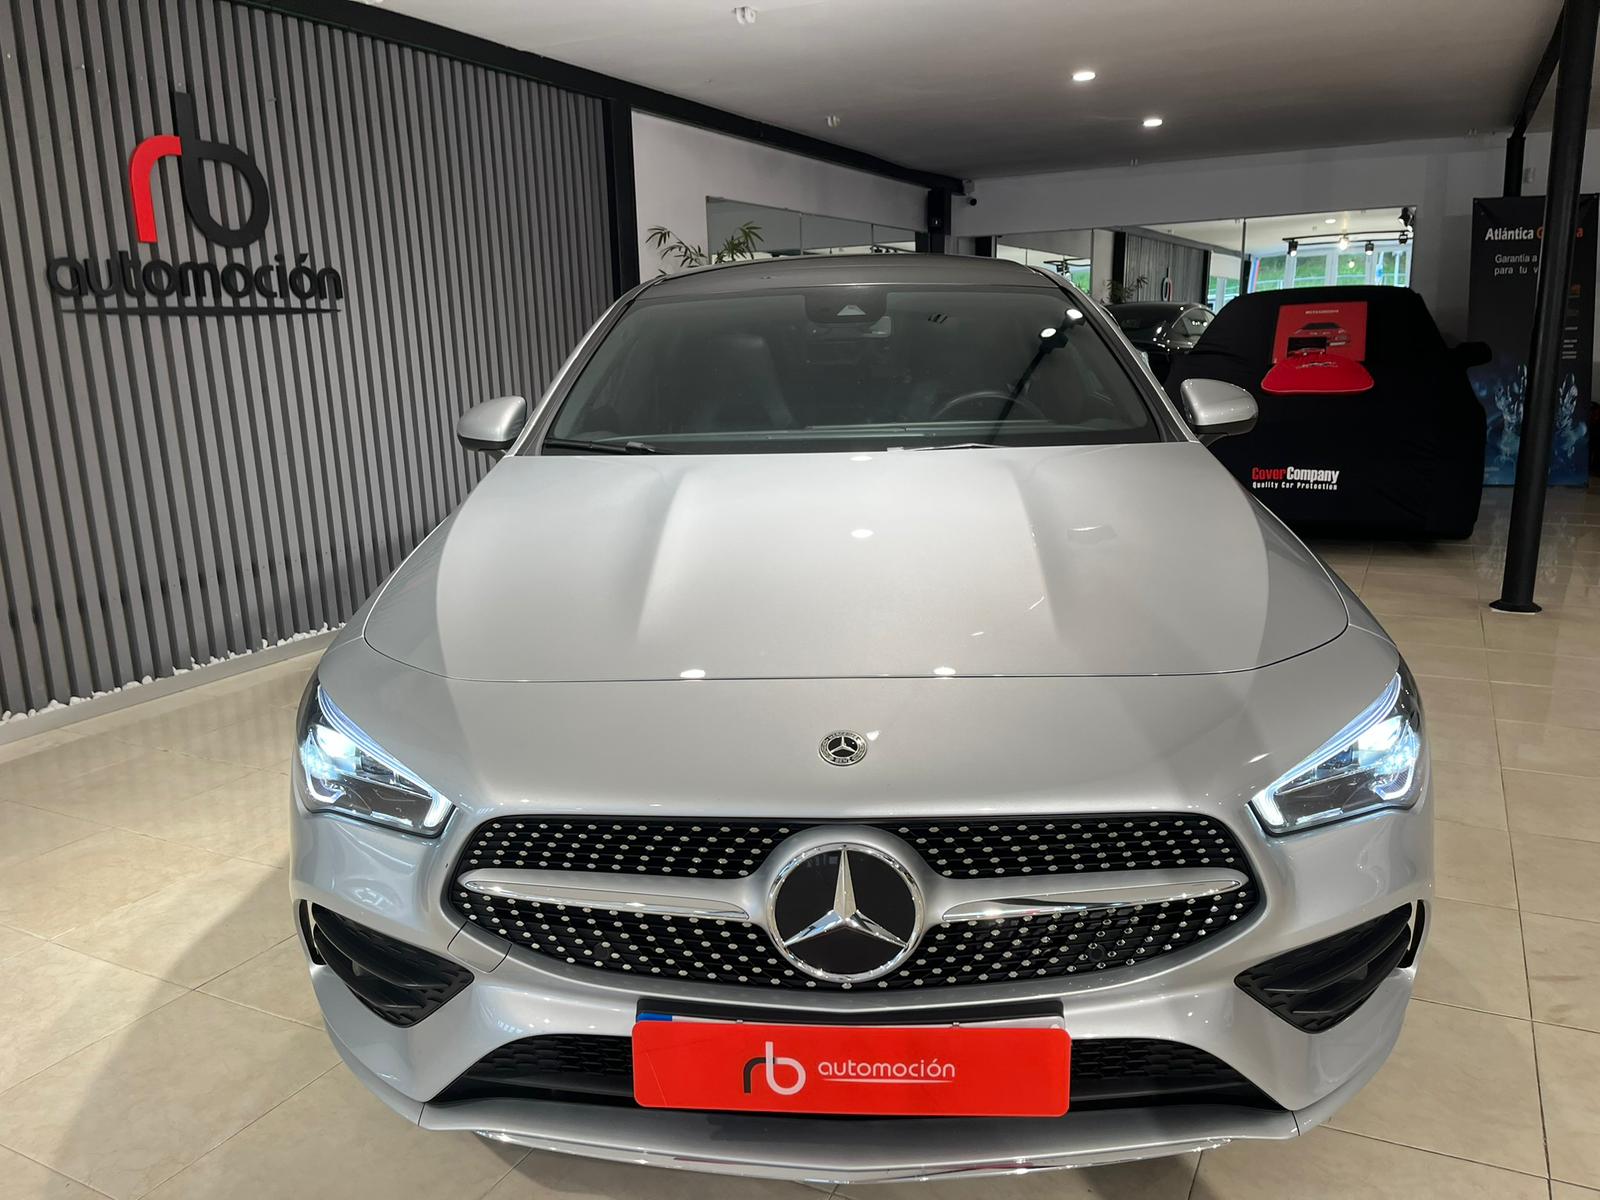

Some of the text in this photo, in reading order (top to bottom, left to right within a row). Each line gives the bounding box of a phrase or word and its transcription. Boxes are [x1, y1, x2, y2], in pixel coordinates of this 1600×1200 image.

[1485, 227, 1534, 240] Atlántica
[1495, 254, 1530, 264] Garantía
[46, 250, 344, 300] automoción
[1494, 266, 1513, 276] para
[1519, 265, 1527, 274] tu
[1252, 481, 1338, 491] Quality Car Protection
[817, 1057, 956, 1079] automoción
